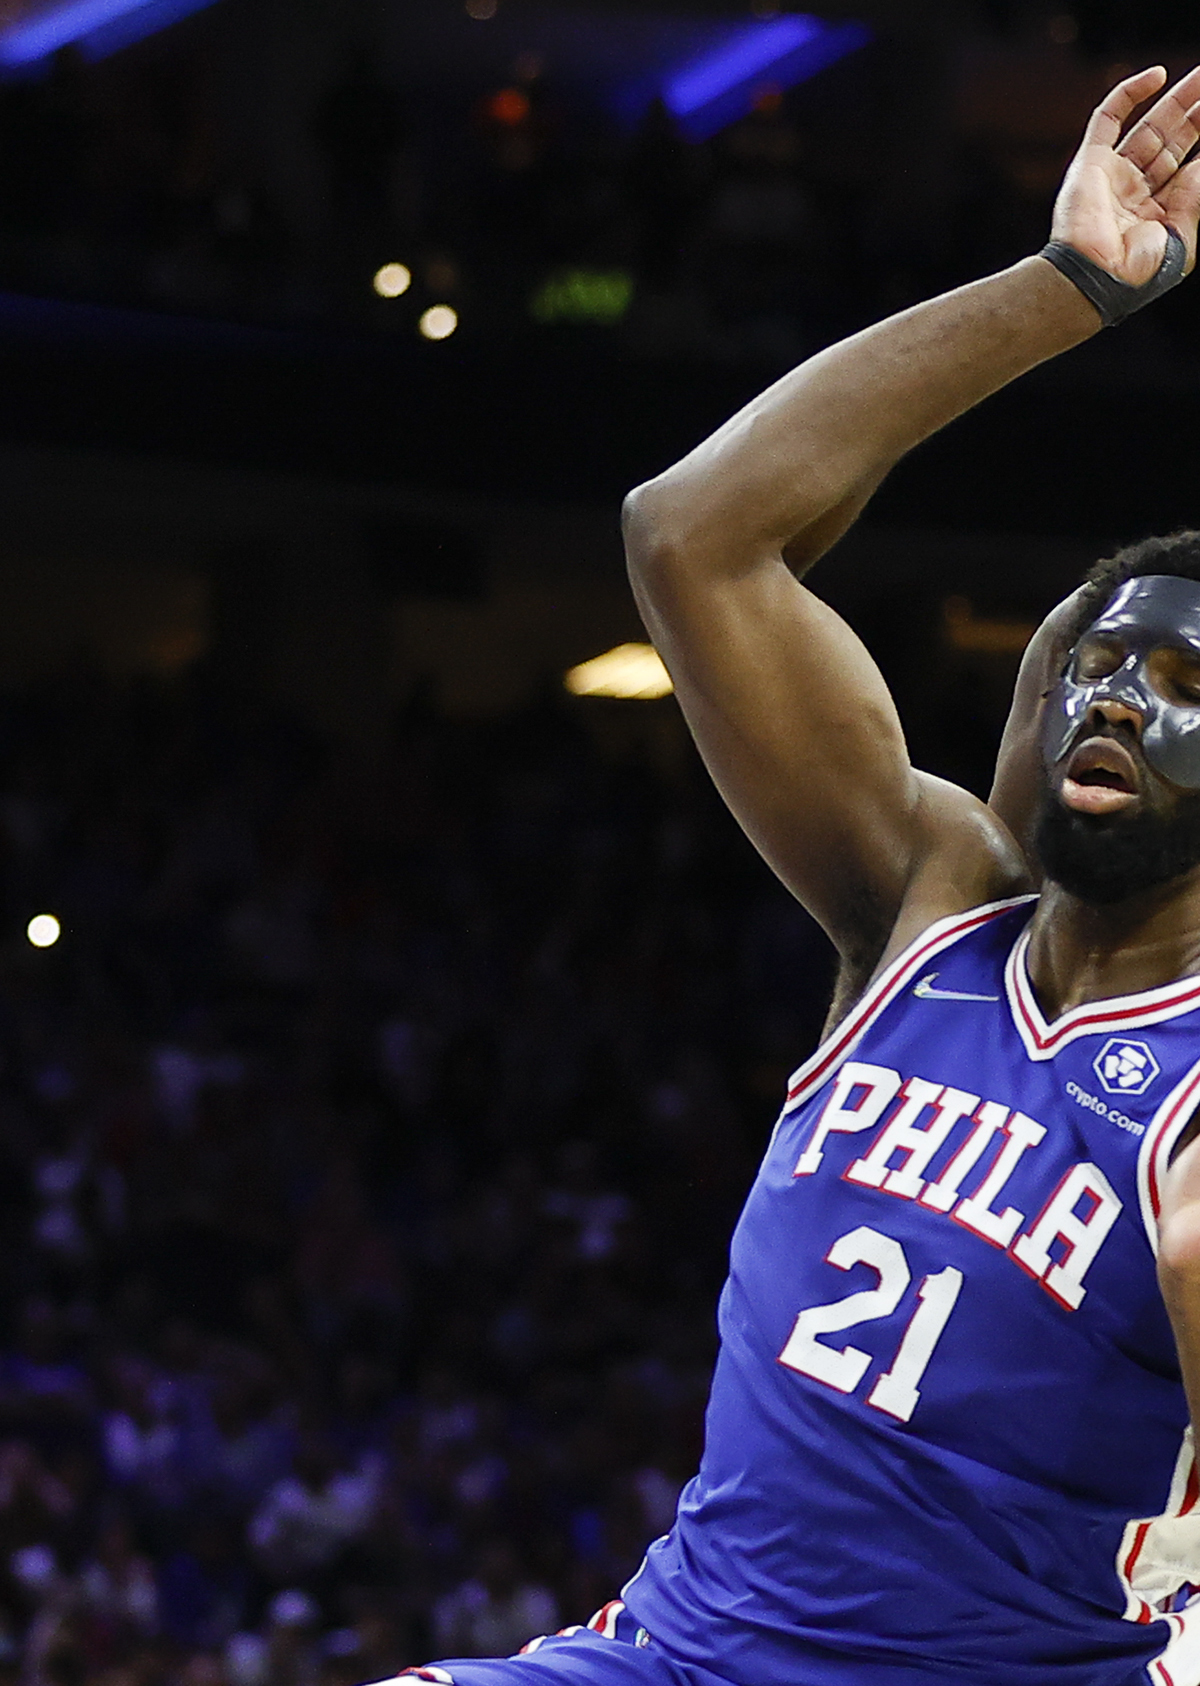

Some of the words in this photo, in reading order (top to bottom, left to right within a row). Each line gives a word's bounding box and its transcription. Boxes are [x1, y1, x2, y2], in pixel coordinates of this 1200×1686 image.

[793, 1062, 1123, 1312] PHILA
[1066, 1081, 1146, 1136] crypto.com
[777, 1226, 964, 1423] 21
